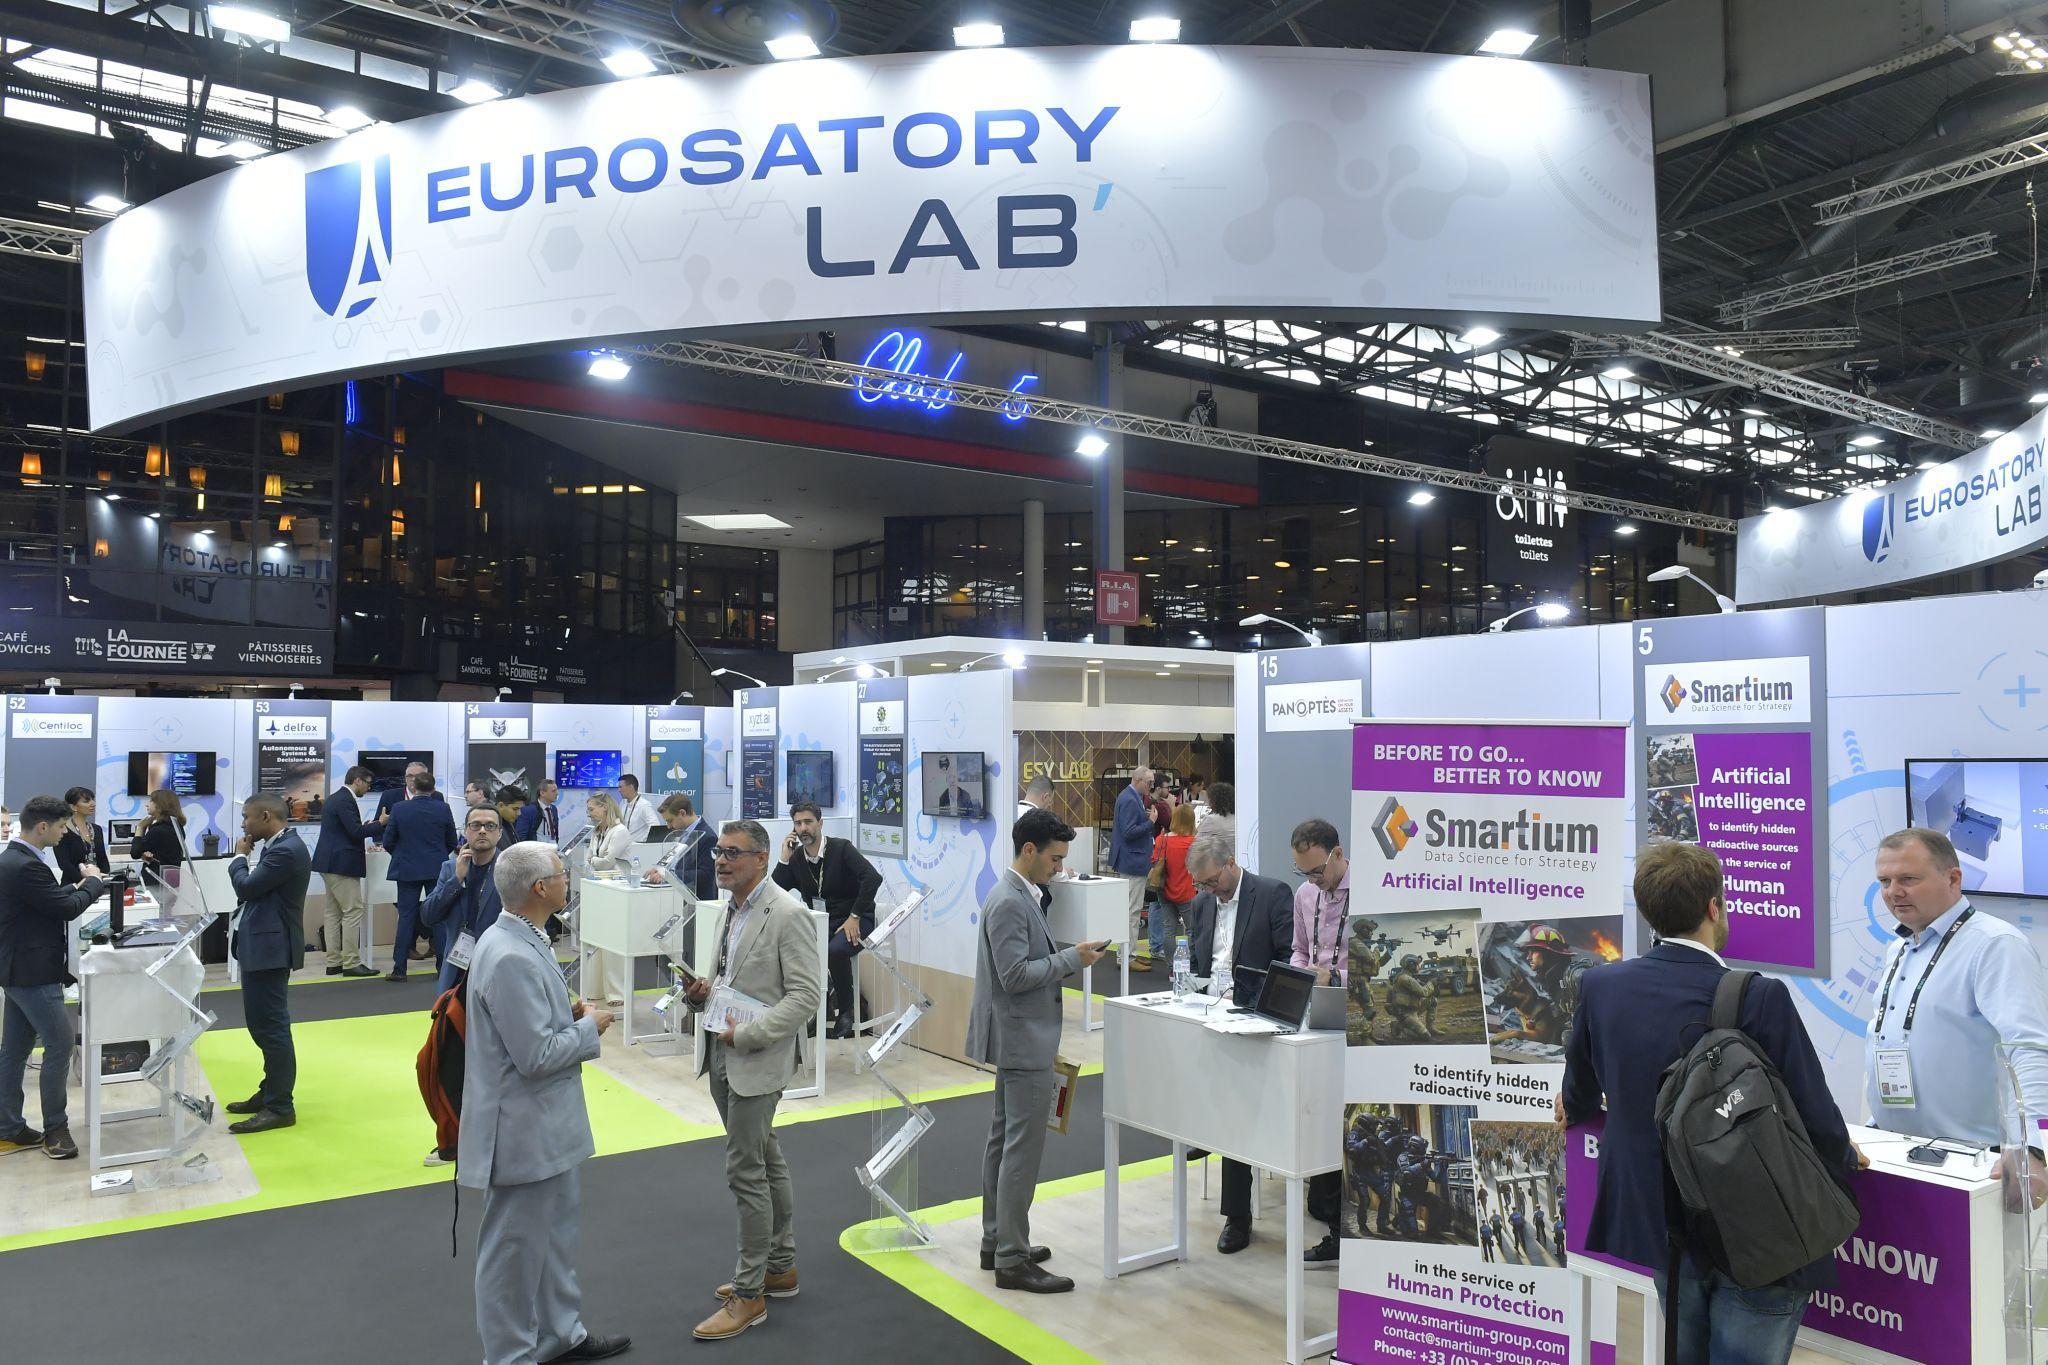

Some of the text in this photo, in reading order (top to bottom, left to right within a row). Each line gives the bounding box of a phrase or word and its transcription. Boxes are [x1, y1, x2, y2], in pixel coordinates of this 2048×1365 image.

[427, 106, 1121, 223] EUROSATORY
[1004, 375, 1039, 420] 5
[1905, 437, 2045, 523] EUROSATORY
[1515, 533, 1553, 548] toilettes
[1519, 549, 1549, 562] toilets
[1101, 580, 1135, 590] R.I.A.
[107, 629, 129, 642] LA
[1639, 627, 1653, 655] 5
[107, 644, 187, 660] FOURNÉE
[248, 641, 313, 654] PÂTISSERIES
[238, 653, 322, 665] VIENNOISERIES
[510, 655, 519, 666] LA
[1261, 656, 1278, 677] 15
[510, 667, 538, 680] FOURNÉE
[741, 692, 749, 704] 39
[858, 684, 867, 699] 27
[1691, 676, 1793, 703] Smartium
[9, 697, 26, 710] 52
[256, 702, 270, 713] 53
[467, 704, 480, 715] 54
[648, 708, 659, 717] 55
[1272, 696, 1337, 717] PANOPTÈS
[1691, 702, 1792, 712] Data Science for Strategy
[284, 723, 318, 732] delfox
[1374, 744, 1525, 763] BEFORE TO GO...
[1059, 761, 1093, 780] LAB
[1434, 767, 1602, 788] BETTER TO KNOW
[1711, 767, 1791, 785] Artificial
[1699, 792, 1806, 814] Intelligence
[1425, 808, 1599, 854] Smartium
[1709, 822, 1796, 835] to identify hidden
[1706, 839, 1799, 853] radioactive sources
[1425, 850, 1597, 872] Data Science for Strategy
[1726, 858, 1741, 867] the
[1744, 859, 1778, 870] service
[1780, 860, 1792, 870] of
[1382, 872, 1585, 901] Artificial Intelligence
[1722, 874, 1785, 895] Human
[1414, 1062, 1549, 1093] to identify hidden
[1409, 1079, 1553, 1110] radioactive sources
[1415, 1260, 1536, 1296] in the service of
[1387, 1272, 1565, 1324] Human Protection
[1381, 1306, 1565, 1355] www.smartium-group.com
[1374, 1340, 1416, 1360] Phone:
[1420, 1350, 1446, 1365] +33
